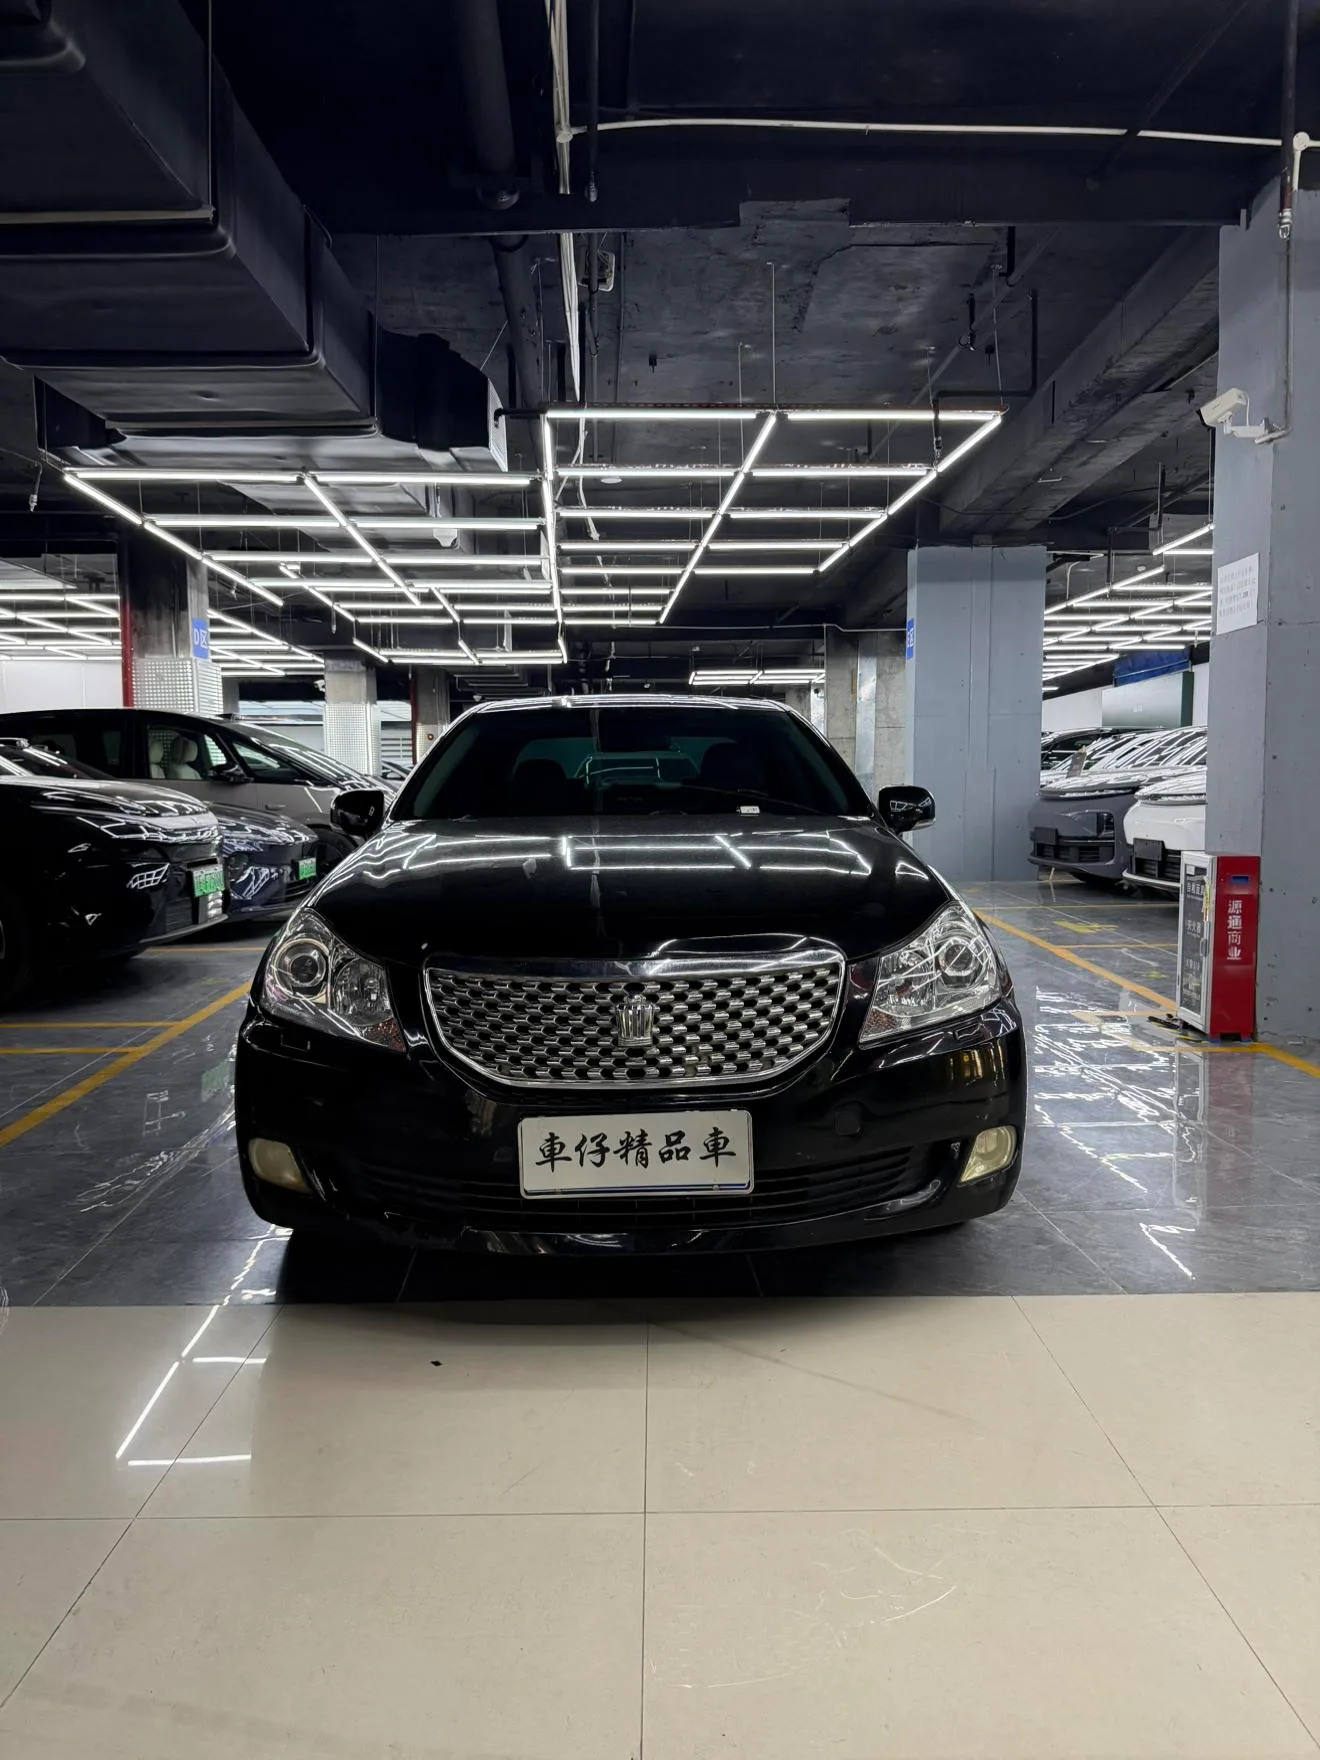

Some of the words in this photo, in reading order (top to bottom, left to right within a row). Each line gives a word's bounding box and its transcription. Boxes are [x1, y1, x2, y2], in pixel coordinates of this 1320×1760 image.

[1227, 899, 1242, 960] 源通商业
[535, 1126, 736, 1173] 車仔精品車
